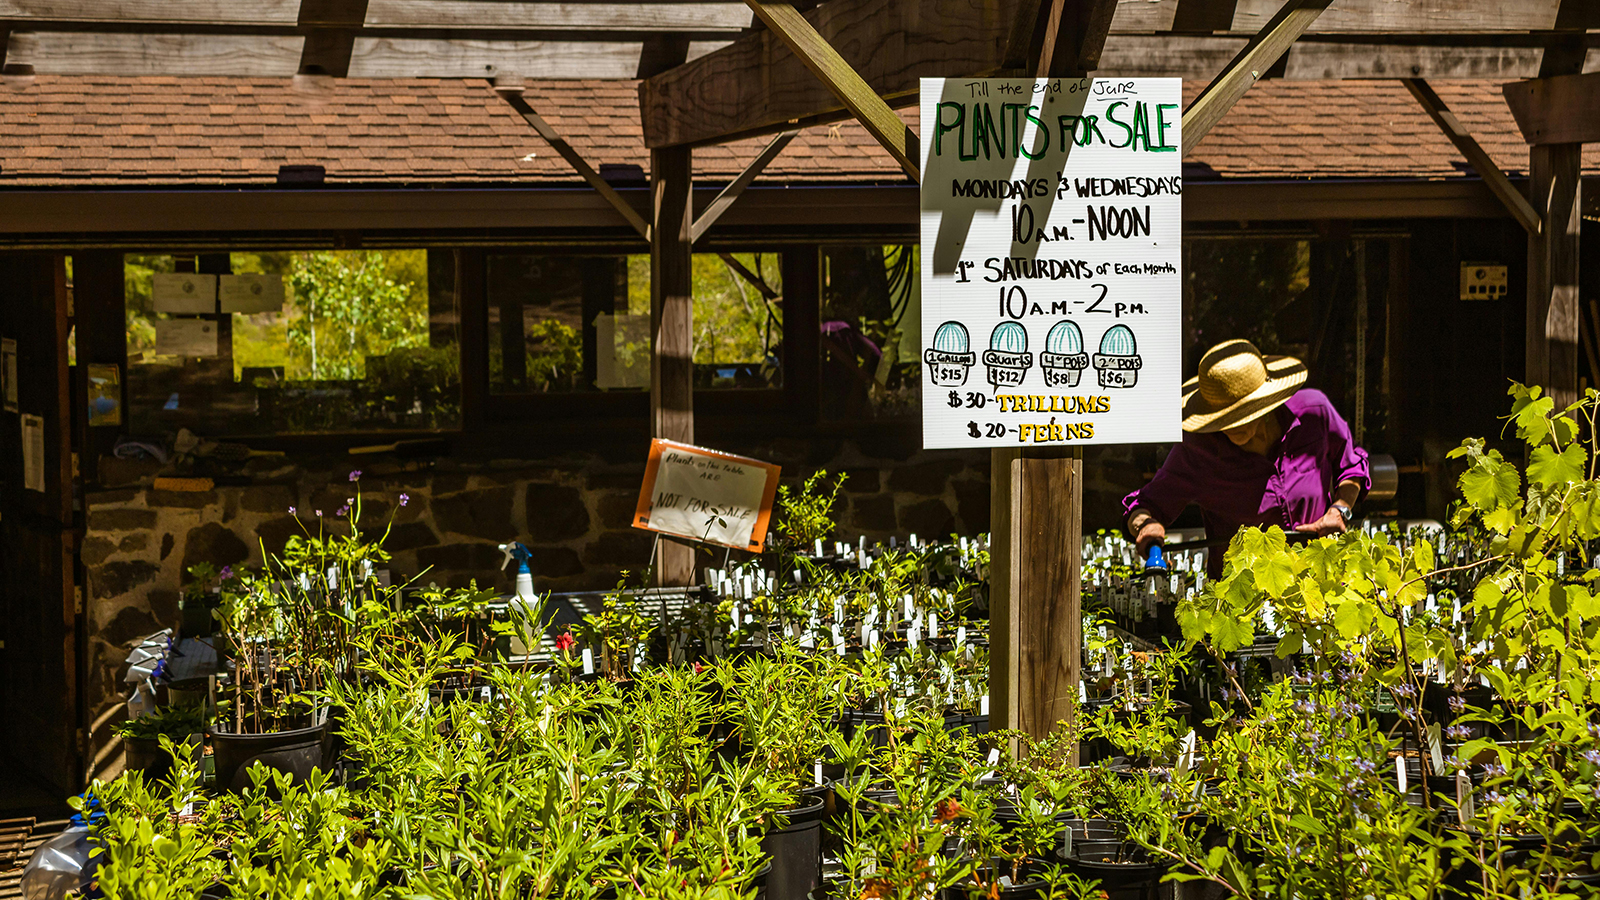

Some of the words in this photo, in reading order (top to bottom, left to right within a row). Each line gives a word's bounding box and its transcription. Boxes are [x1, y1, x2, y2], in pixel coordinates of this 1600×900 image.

[965, 81, 989, 98] Till
[997, 81, 1023, 95] the
[1031, 79, 1062, 94] end
[1069, 79, 1088, 94] of
[1093, 80, 1138, 96] June
[936, 101, 1050, 161] PLANTS
[1058, 114, 1106, 153] FOR
[1106, 101, 1179, 152] SALE
[952, 178, 1049, 200] MONDAYS
[1074, 176, 1182, 198] WEDNESDAYS
[983, 257, 1093, 282] SATURDAYS
[1096, 262, 1111, 275] of
[1114, 263, 1142, 275] Each
[1143, 262, 1176, 275] Month
[986, 352, 1031, 367] Quarts
[941, 368, 962, 380] $15
[998, 370, 1019, 383] $12
[1053, 372, 1068, 386] $8
[666, 453, 694, 465] Plants
[656, 492, 683, 508] NOT
[684, 497, 710, 514] FOR
[718, 503, 752, 520] SALE
